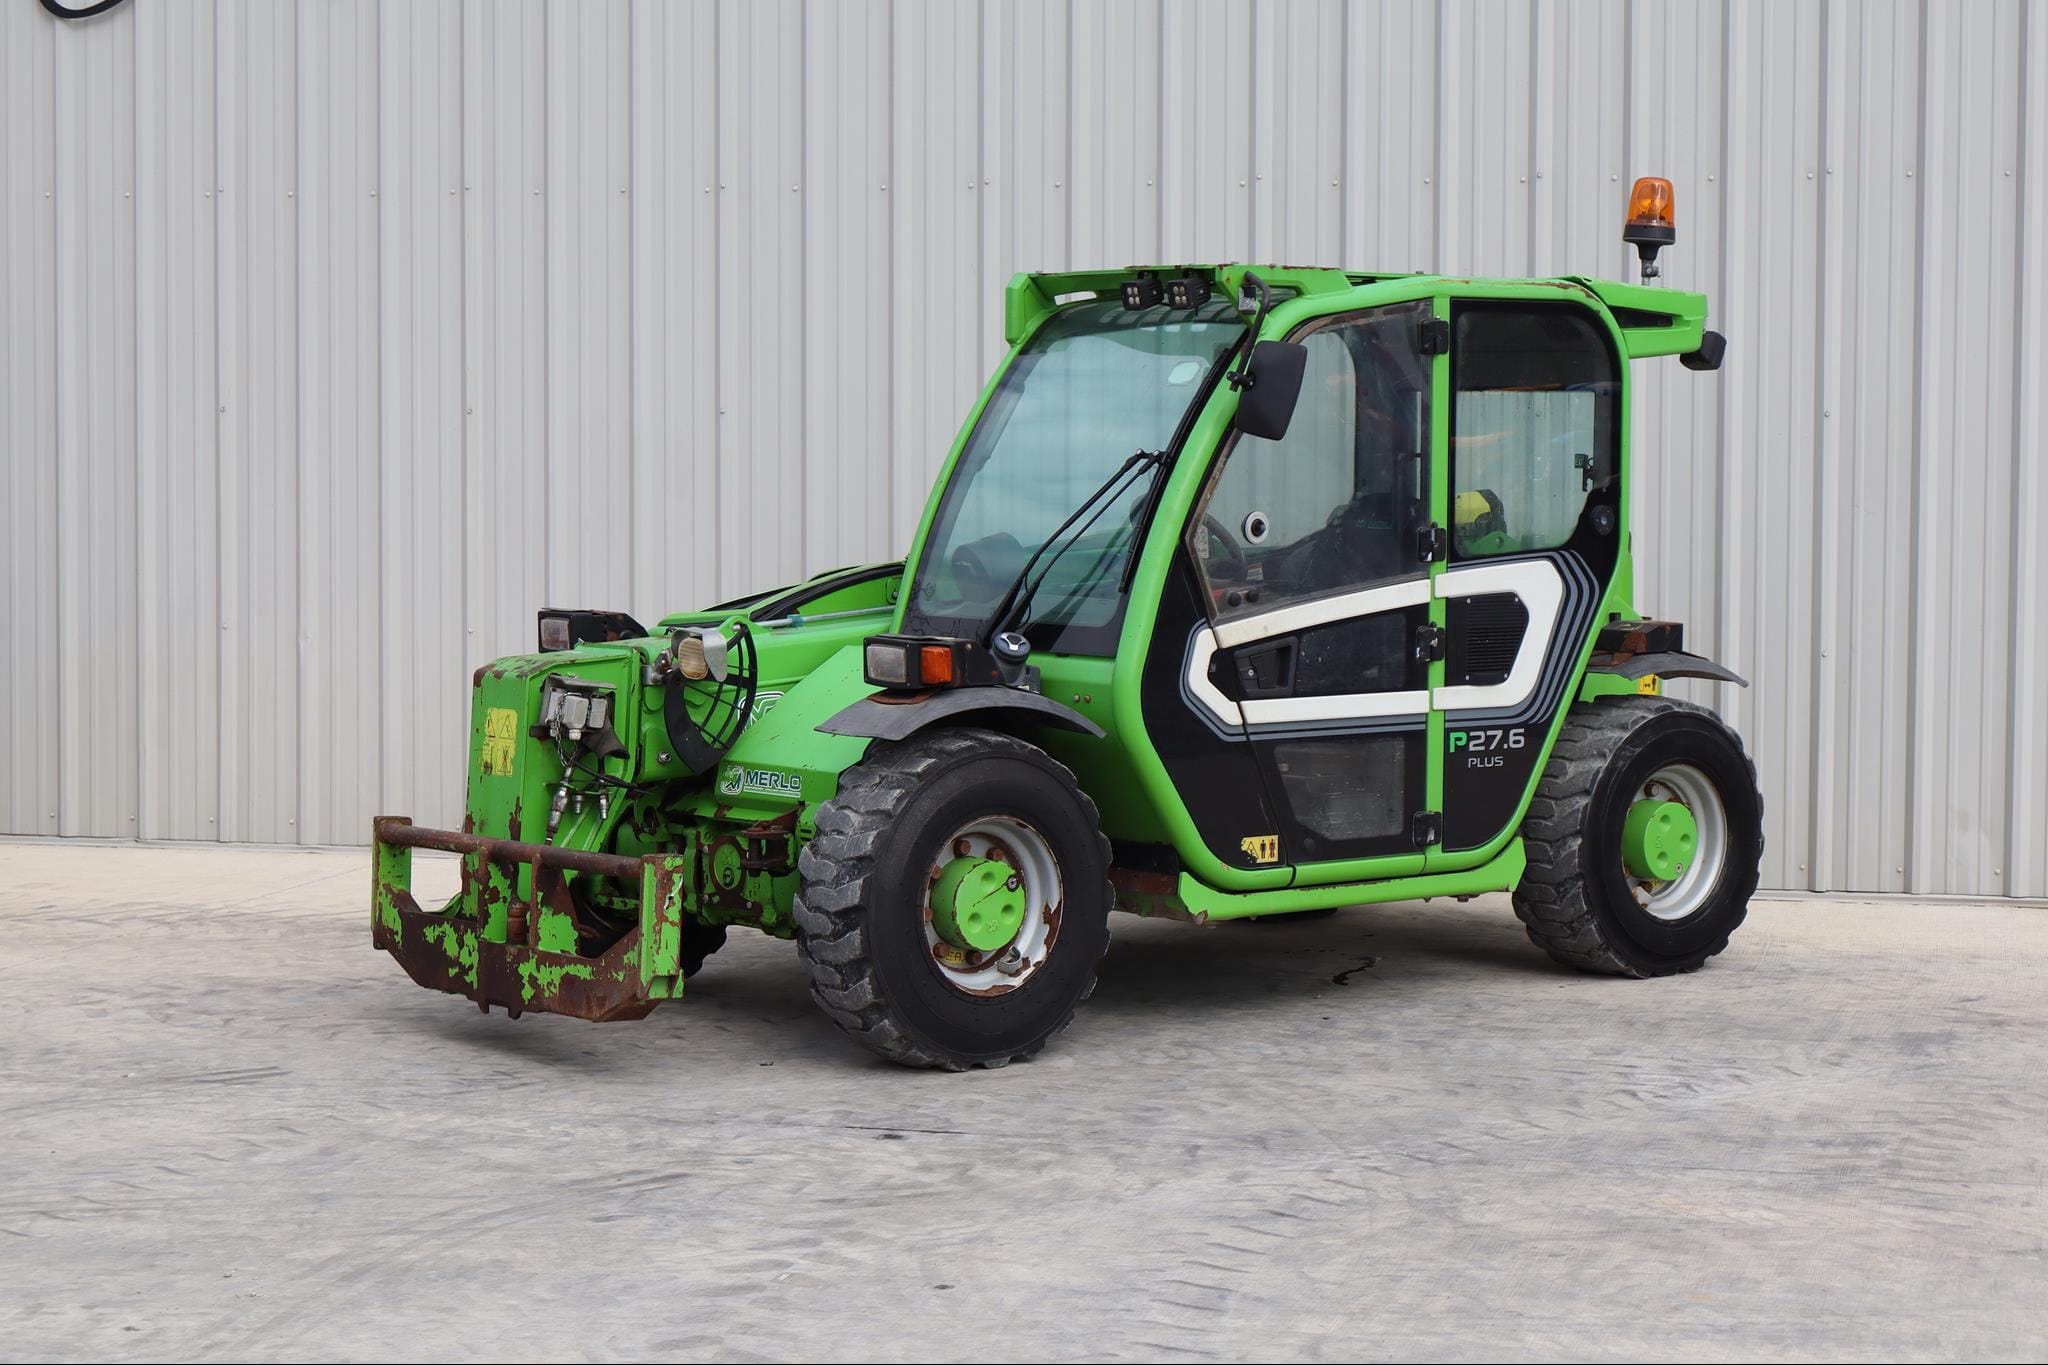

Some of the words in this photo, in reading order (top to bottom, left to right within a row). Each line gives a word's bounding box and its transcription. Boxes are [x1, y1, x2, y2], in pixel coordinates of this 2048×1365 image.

[1450, 728, 1525, 752] P27.6
[1468, 756, 1504, 768] PLUS
[745, 770, 801, 791] MERLO
